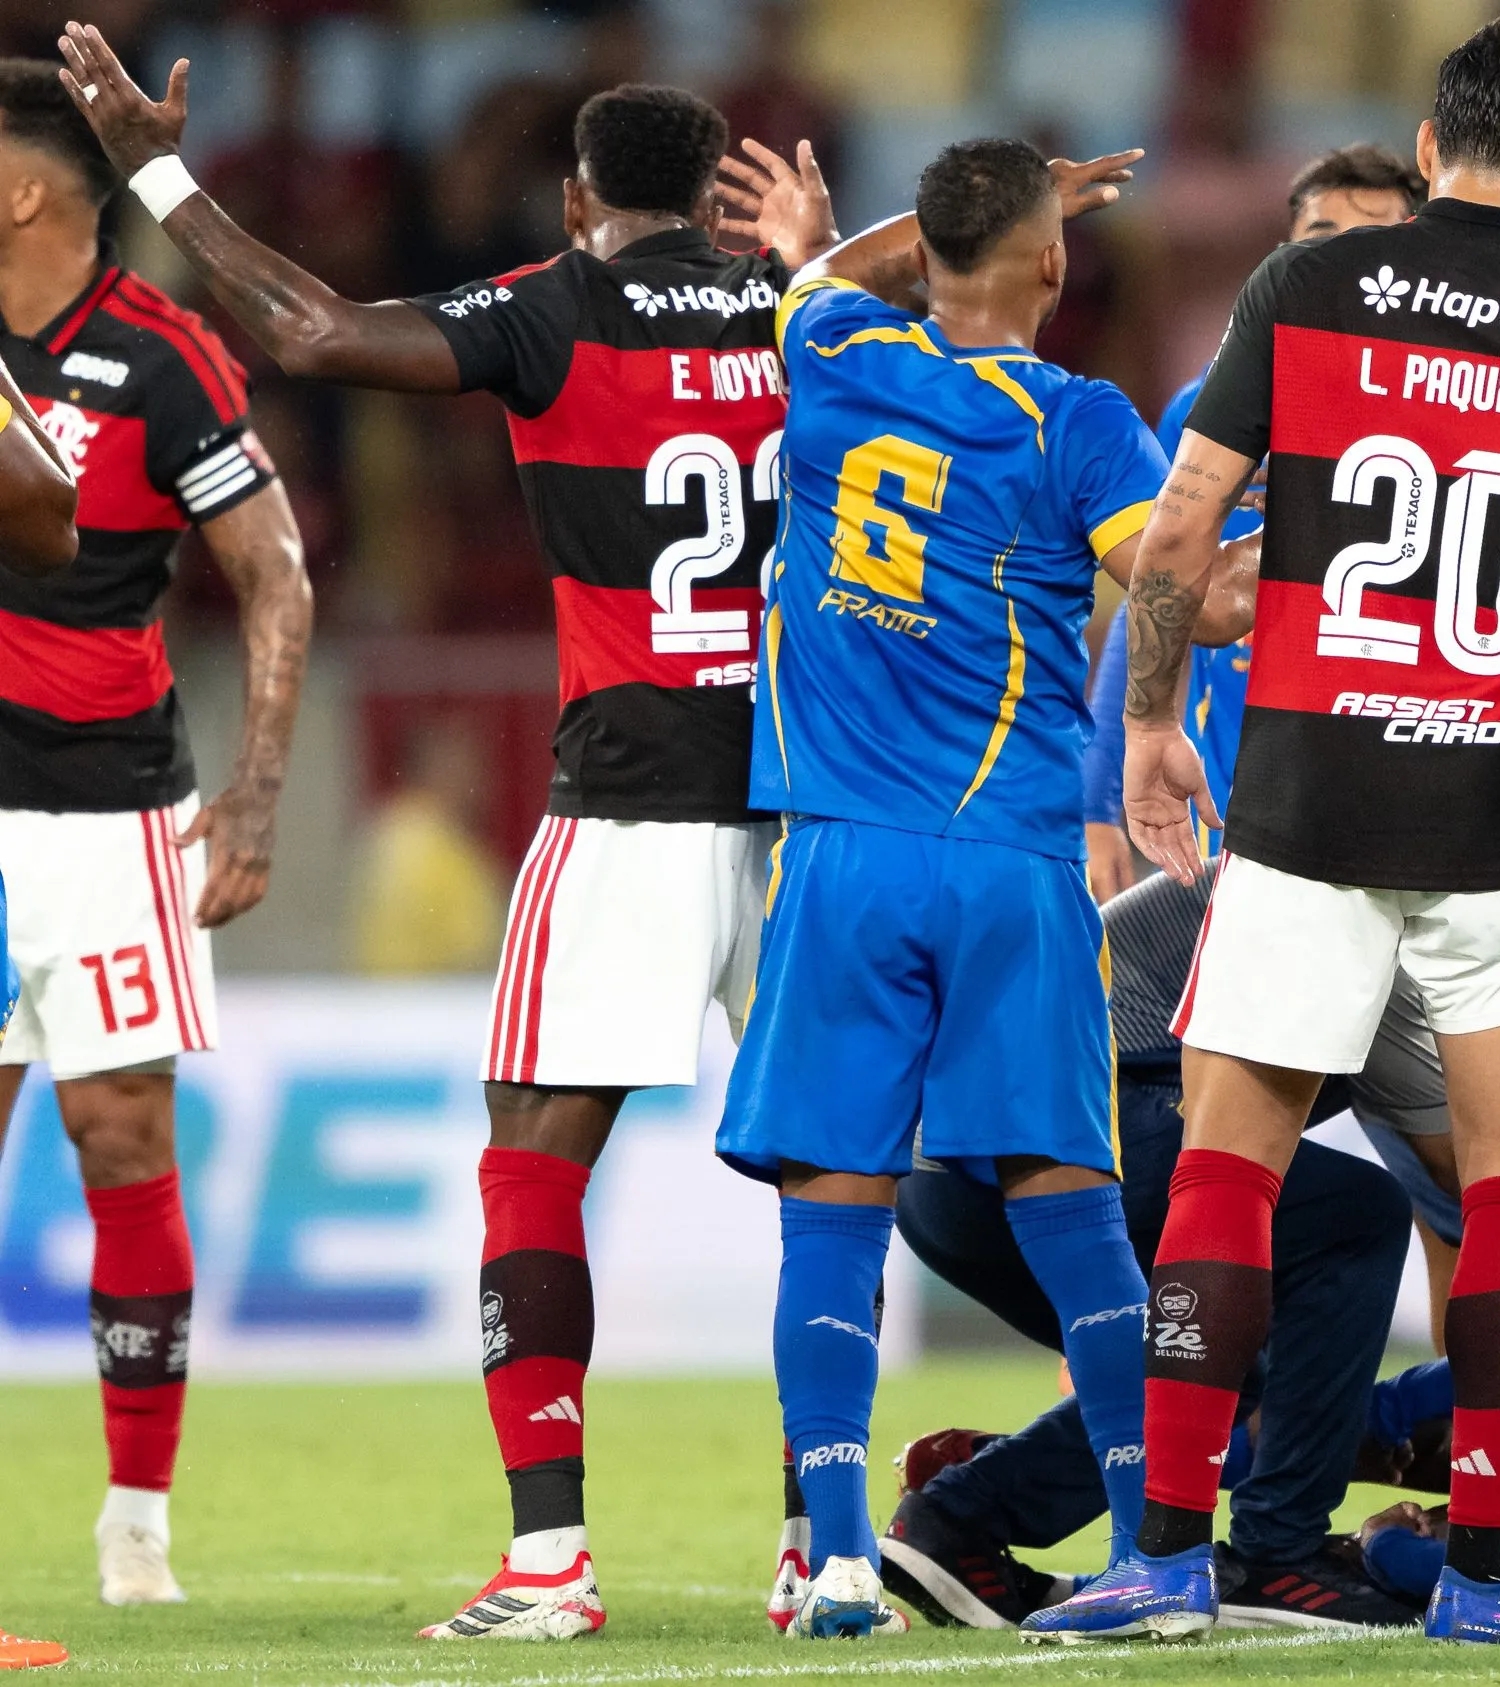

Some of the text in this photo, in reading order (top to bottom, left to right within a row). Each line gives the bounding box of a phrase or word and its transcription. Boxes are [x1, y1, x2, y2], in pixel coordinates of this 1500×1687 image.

[668, 279, 780, 318] Hapvid
[671, 354, 701, 400] E.
[1360, 348, 1388, 396] L.
[719, 468, 732, 528] TEXACO
[829, 434, 953, 604] 6
[1405, 477, 1422, 537] TEXACO
[1331, 692, 1495, 722] ASSIST
[80, 944, 159, 1033] 13
[1155, 1322, 1207, 1350] Zé
[1155, 1349, 1207, 1360] DELIVERY
